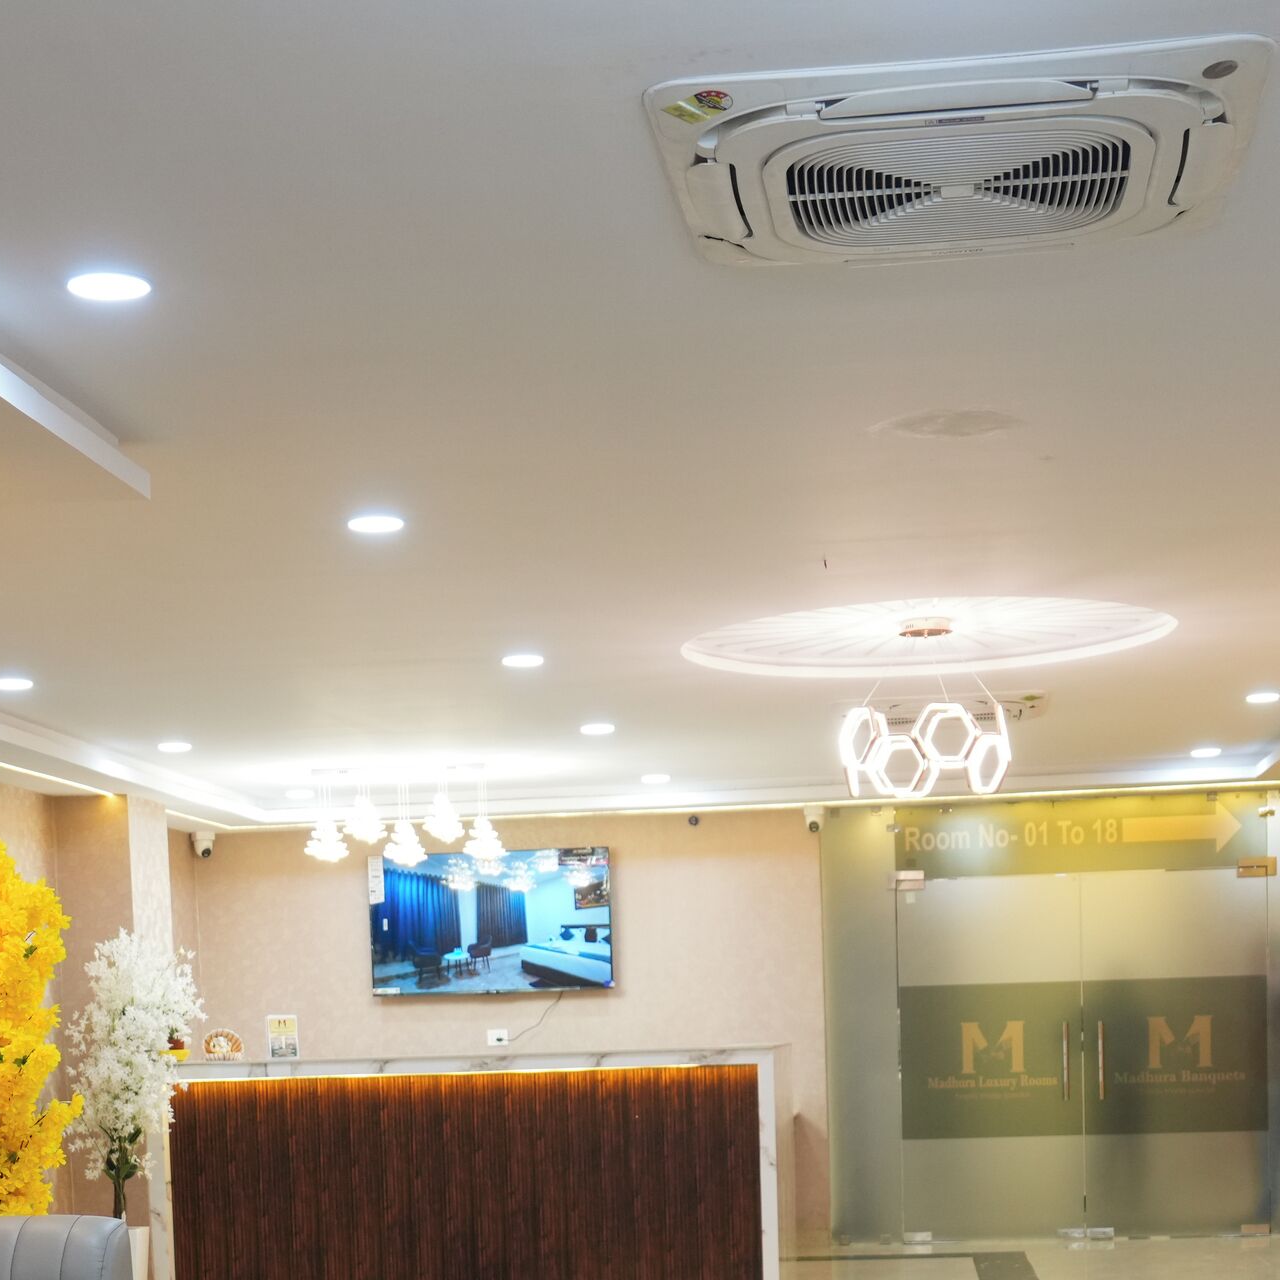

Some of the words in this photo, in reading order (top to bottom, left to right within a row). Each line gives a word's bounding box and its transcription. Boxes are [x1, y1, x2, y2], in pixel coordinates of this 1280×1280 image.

[904, 826, 970, 851] Room
[978, 823, 1018, 849] No-
[1024, 821, 1048, 847] 01
[1057, 819, 1085, 845] To
[1092, 818, 1118, 844] 18
[927, 1076, 976, 1089] Madhura
[979, 1075, 1018, 1091] Luxury
[1021, 1074, 1058, 1088] Rooms
[1113, 1070, 1177, 1084] Madhura
[1181, 1069, 1246, 1085] Banquets
